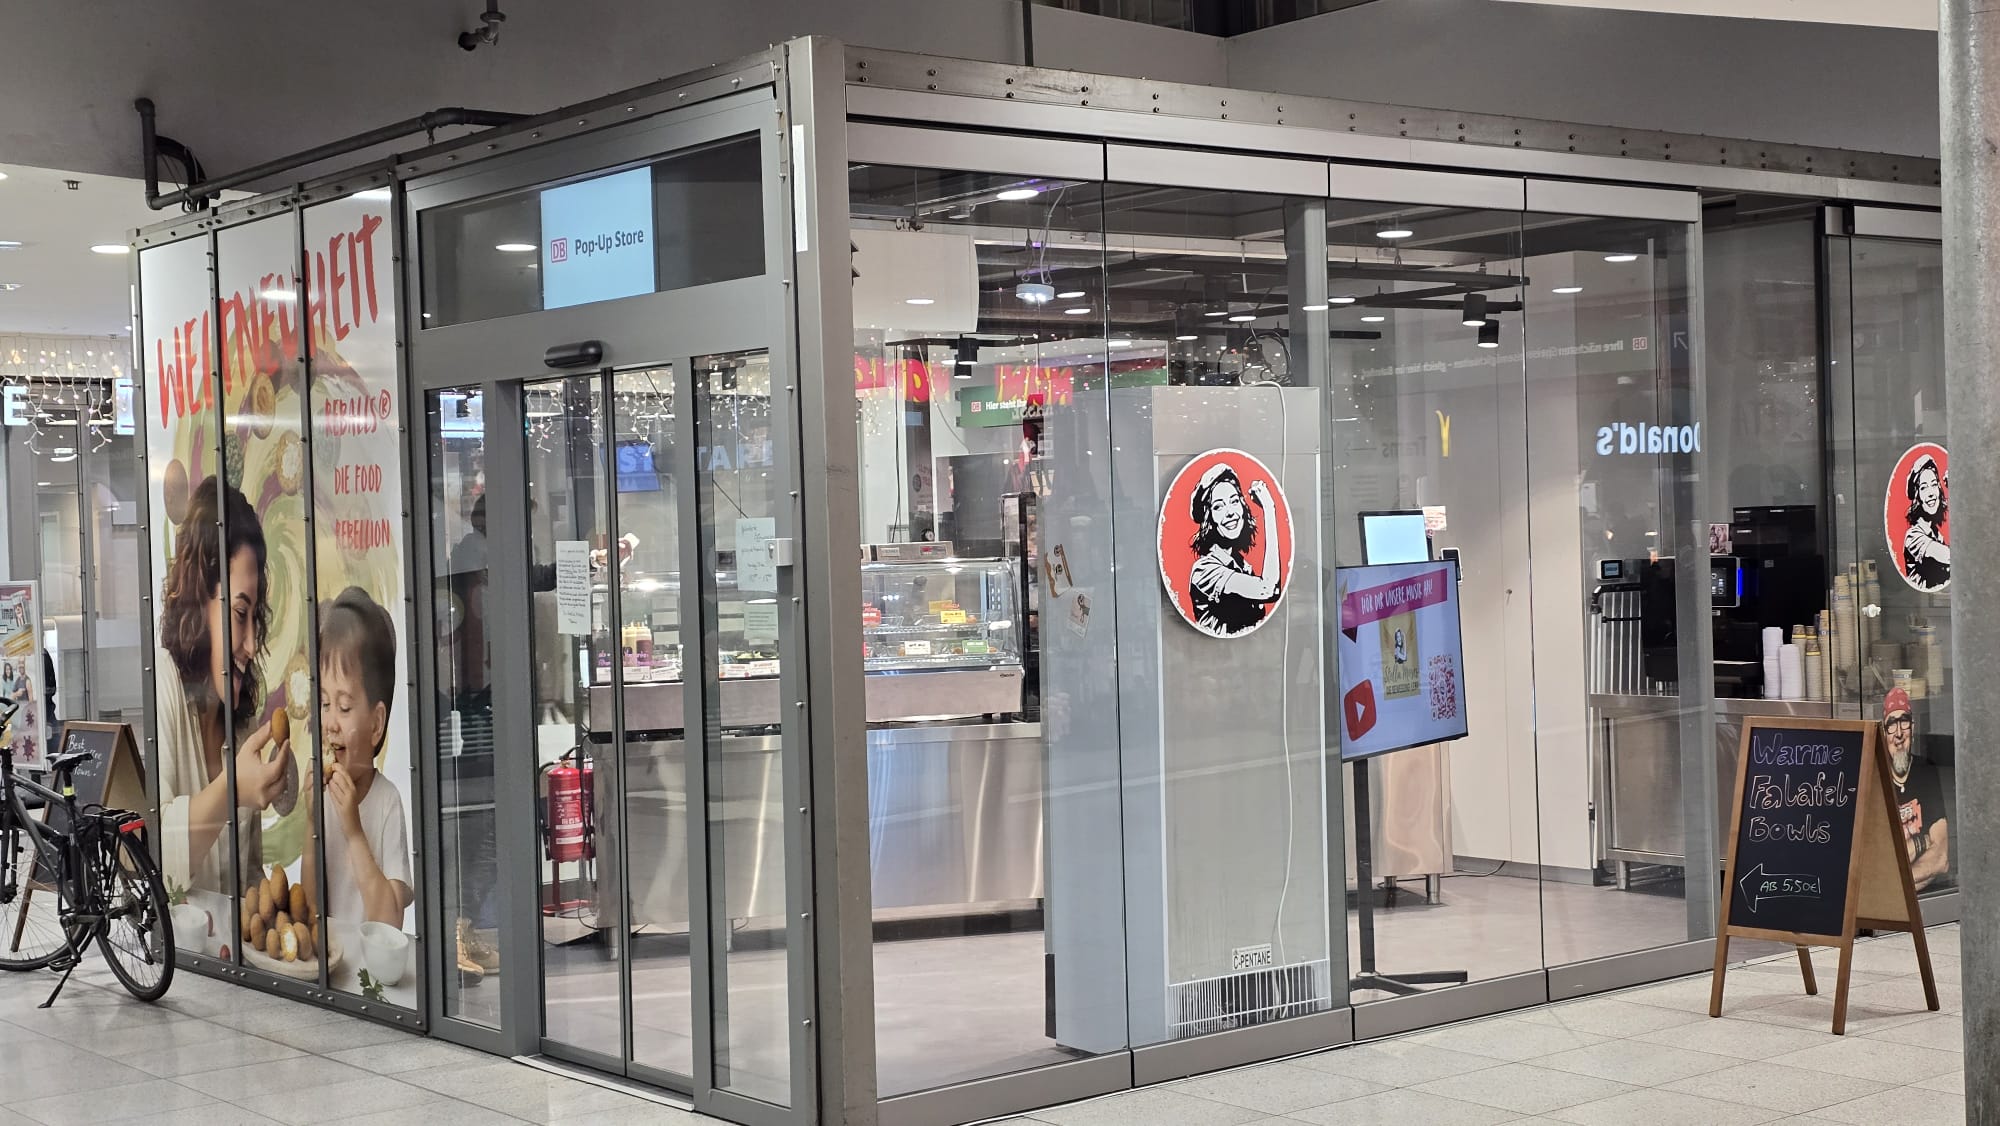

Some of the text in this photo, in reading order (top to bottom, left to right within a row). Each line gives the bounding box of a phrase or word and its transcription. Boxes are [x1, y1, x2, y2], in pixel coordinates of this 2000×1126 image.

[575, 234, 612, 256] Pop-Up
[615, 229, 644, 248] Store
[157, 214, 383, 429] WELTNEUHEIT
[335, 463, 382, 495] DIE FOOD
[336, 517, 390, 550] REBELLION
[68, 734, 85, 751] Best
[1753, 733, 1844, 765] Warme
[1749, 771, 1856, 809] Falafel-
[1749, 814, 1831, 843] Bowls
[1760, 881, 1778, 892] AB
[1233, 950, 1271, 969] C-PENTANE
